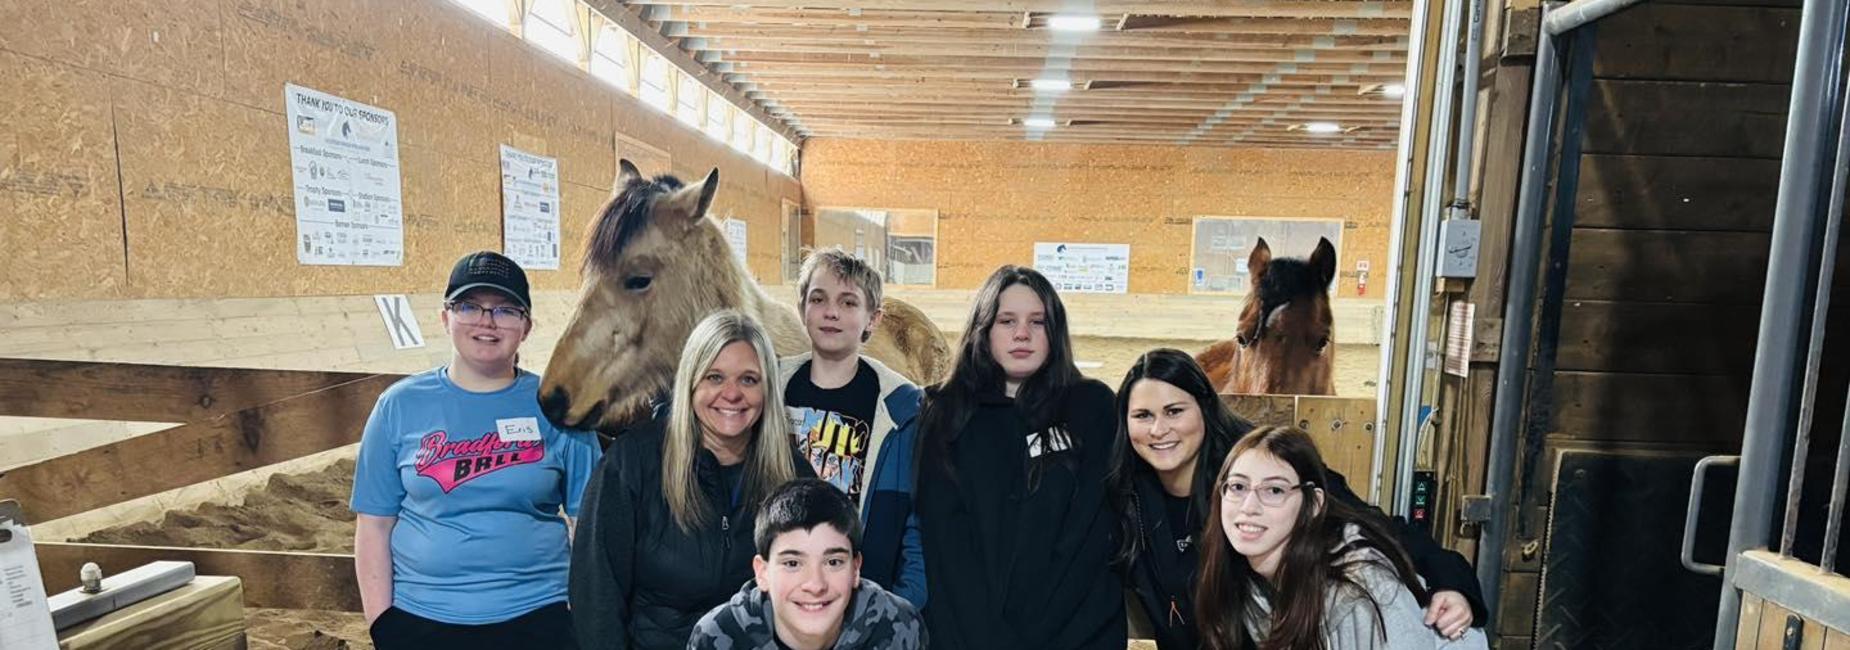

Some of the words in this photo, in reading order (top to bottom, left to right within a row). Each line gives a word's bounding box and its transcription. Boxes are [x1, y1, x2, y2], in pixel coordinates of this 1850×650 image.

[296, 92, 320, 109] THANK
[321, 100, 333, 112] YOU
[334, 103, 343, 114] TO
[358, 109, 389, 126] SPONSORS
[381, 297, 419, 346] K
